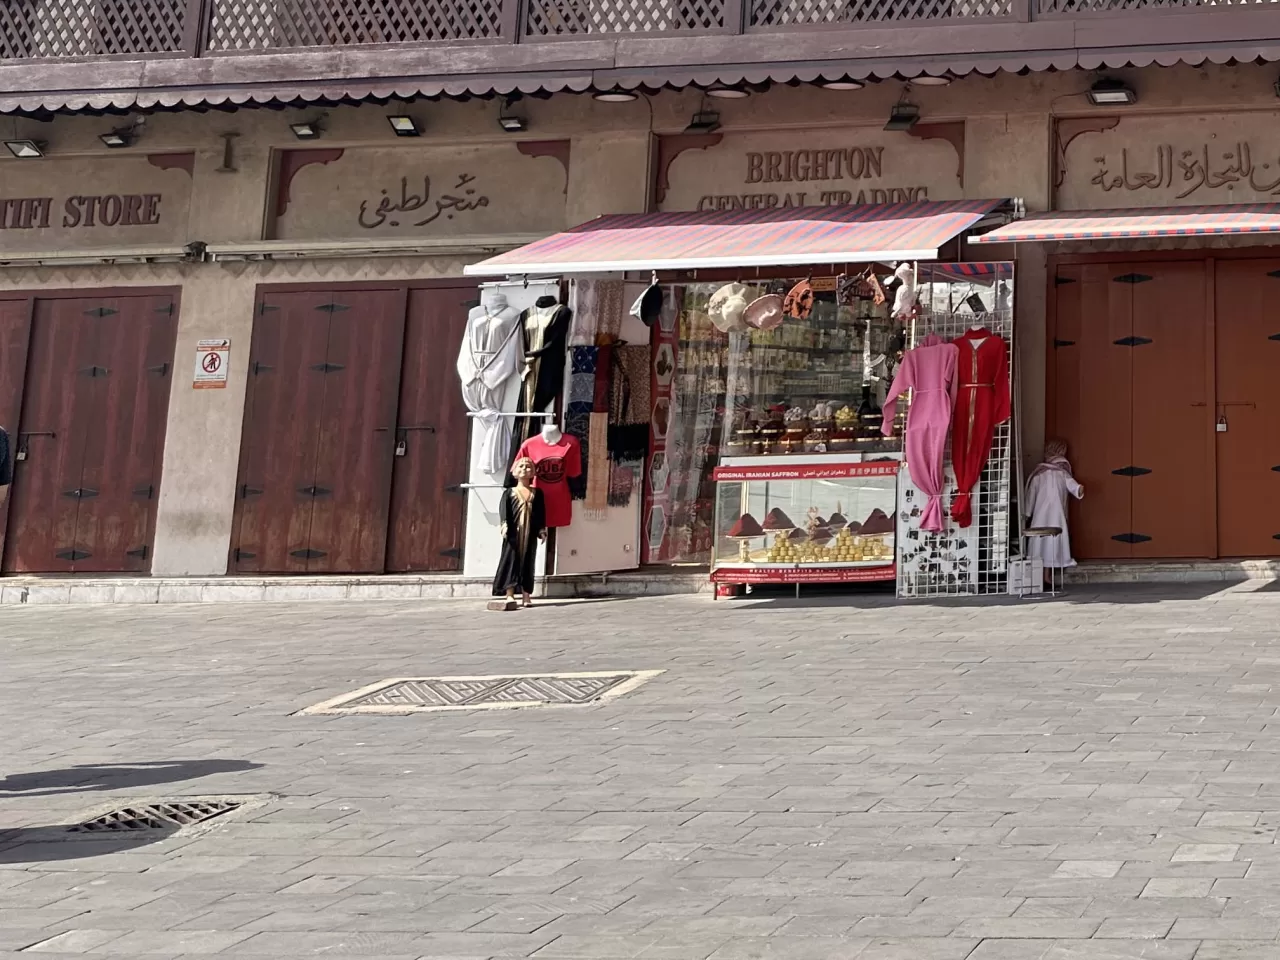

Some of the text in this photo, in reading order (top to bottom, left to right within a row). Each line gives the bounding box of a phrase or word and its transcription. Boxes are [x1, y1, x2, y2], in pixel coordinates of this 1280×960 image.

[745, 146, 884, 184] BRIGHTON
[1090, 144, 1172, 192] العامة
[62, 193, 162, 228] STORE
